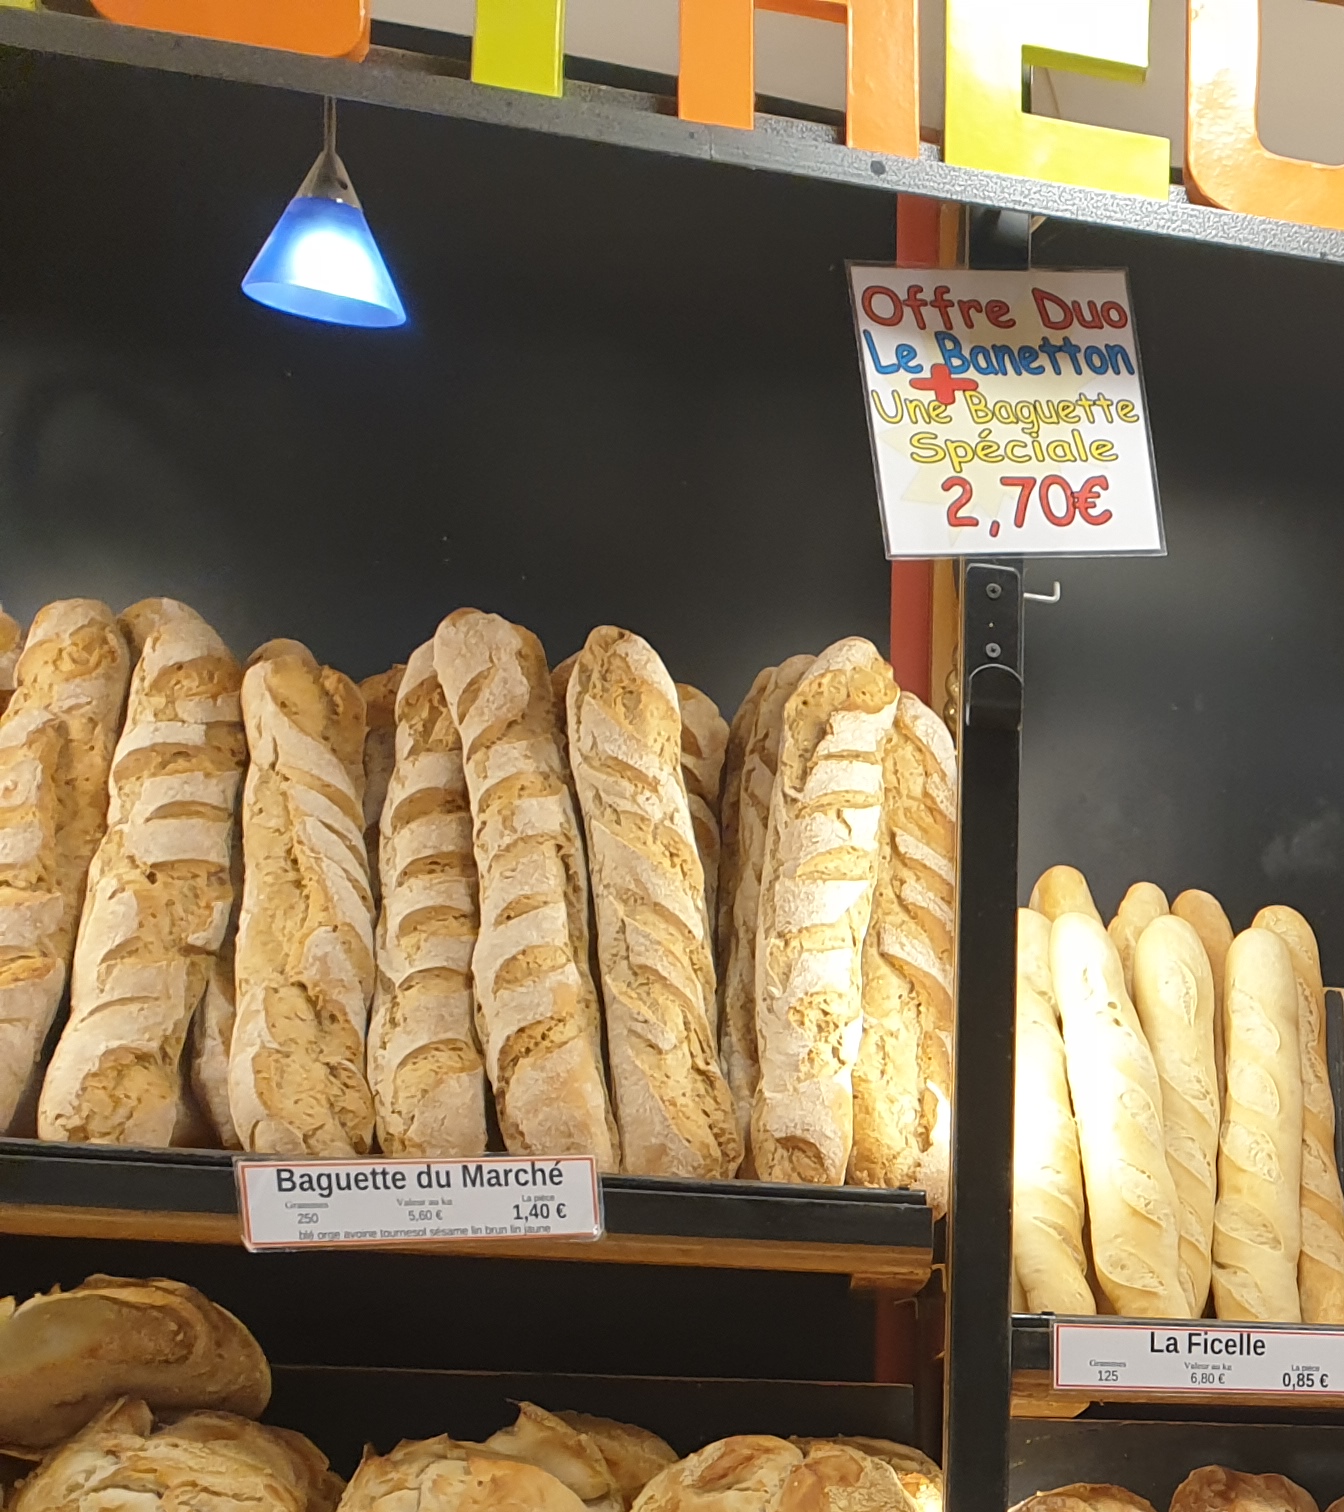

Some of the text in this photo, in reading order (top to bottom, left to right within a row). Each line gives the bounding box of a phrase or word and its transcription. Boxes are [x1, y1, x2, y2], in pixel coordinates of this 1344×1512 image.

[861, 285, 1128, 330] Offre Duo
[863, 329, 1135, 376] Le Banetton
[871, 389, 1140, 435] Une Baguette
[910, 429, 1119, 472] Spéciale
[941, 475, 1113, 538] 2,70€
[276, 1161, 564, 1198] Baguette du Marché
[297, 1212, 319, 1225] 250
[408, 1210, 430, 1222] 5,60
[513, 1203, 567, 1222] 1,40 €
[1150, 1331, 1266, 1356] La Ficelle
[1097, 1370, 1119, 1382] 125
[1191, 1372, 1215, 1386] 6,80
[1282, 1372, 1329, 1390] 0,85 €
